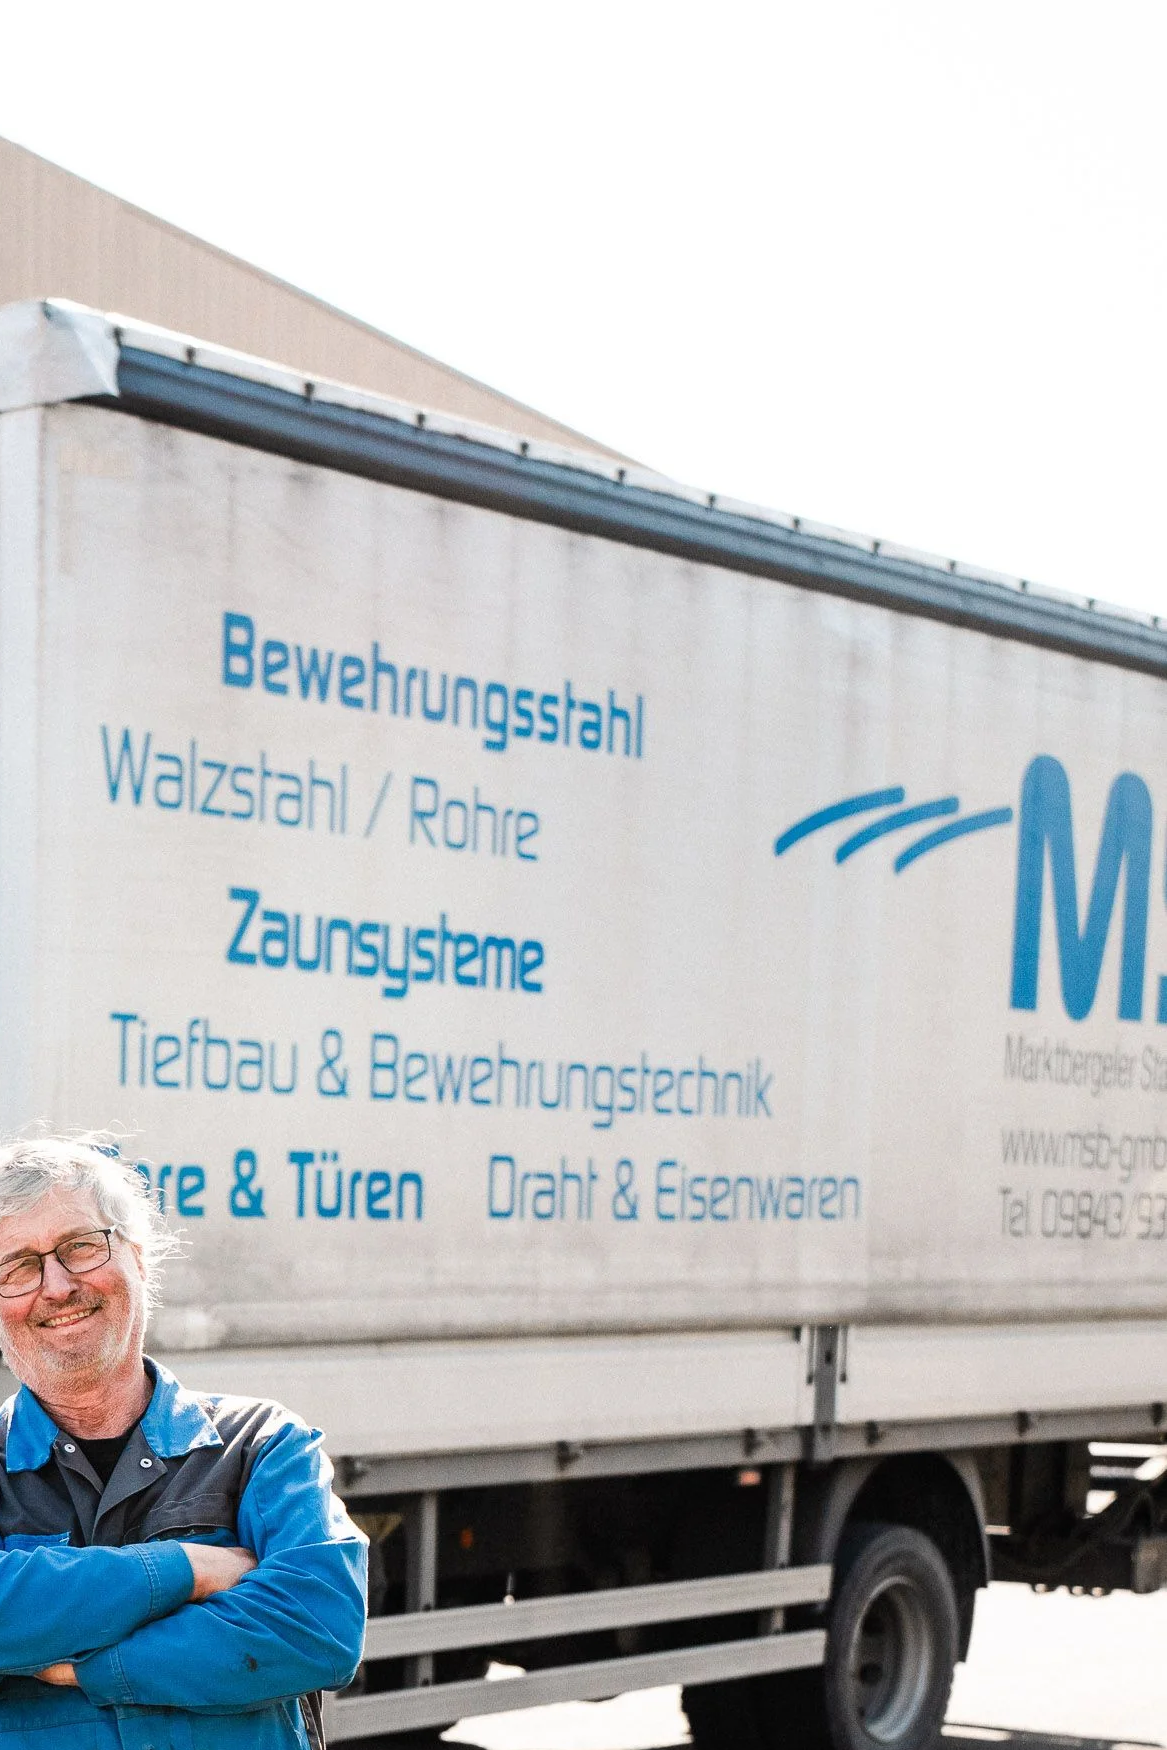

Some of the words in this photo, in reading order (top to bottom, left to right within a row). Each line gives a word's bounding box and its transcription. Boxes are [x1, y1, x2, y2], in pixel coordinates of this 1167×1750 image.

[222, 611, 644, 758] Bewehrungsstahl
[101, 724, 349, 836] Walzstahl
[410, 775, 540, 862] Rohre
[226, 886, 546, 1000] Zaunsysteme
[1010, 754, 1167, 1026] M
[109, 1011, 297, 1095] Tiefbau
[317, 1028, 349, 1098] &
[370, 1032, 774, 1130] Bewehrungstechnik
[228, 1147, 267, 1220] &
[287, 1148, 424, 1221] Türen
[488, 1153, 598, 1220] Draht
[613, 1158, 640, 1221] &
[656, 1159, 861, 1222] Eisenwaren
